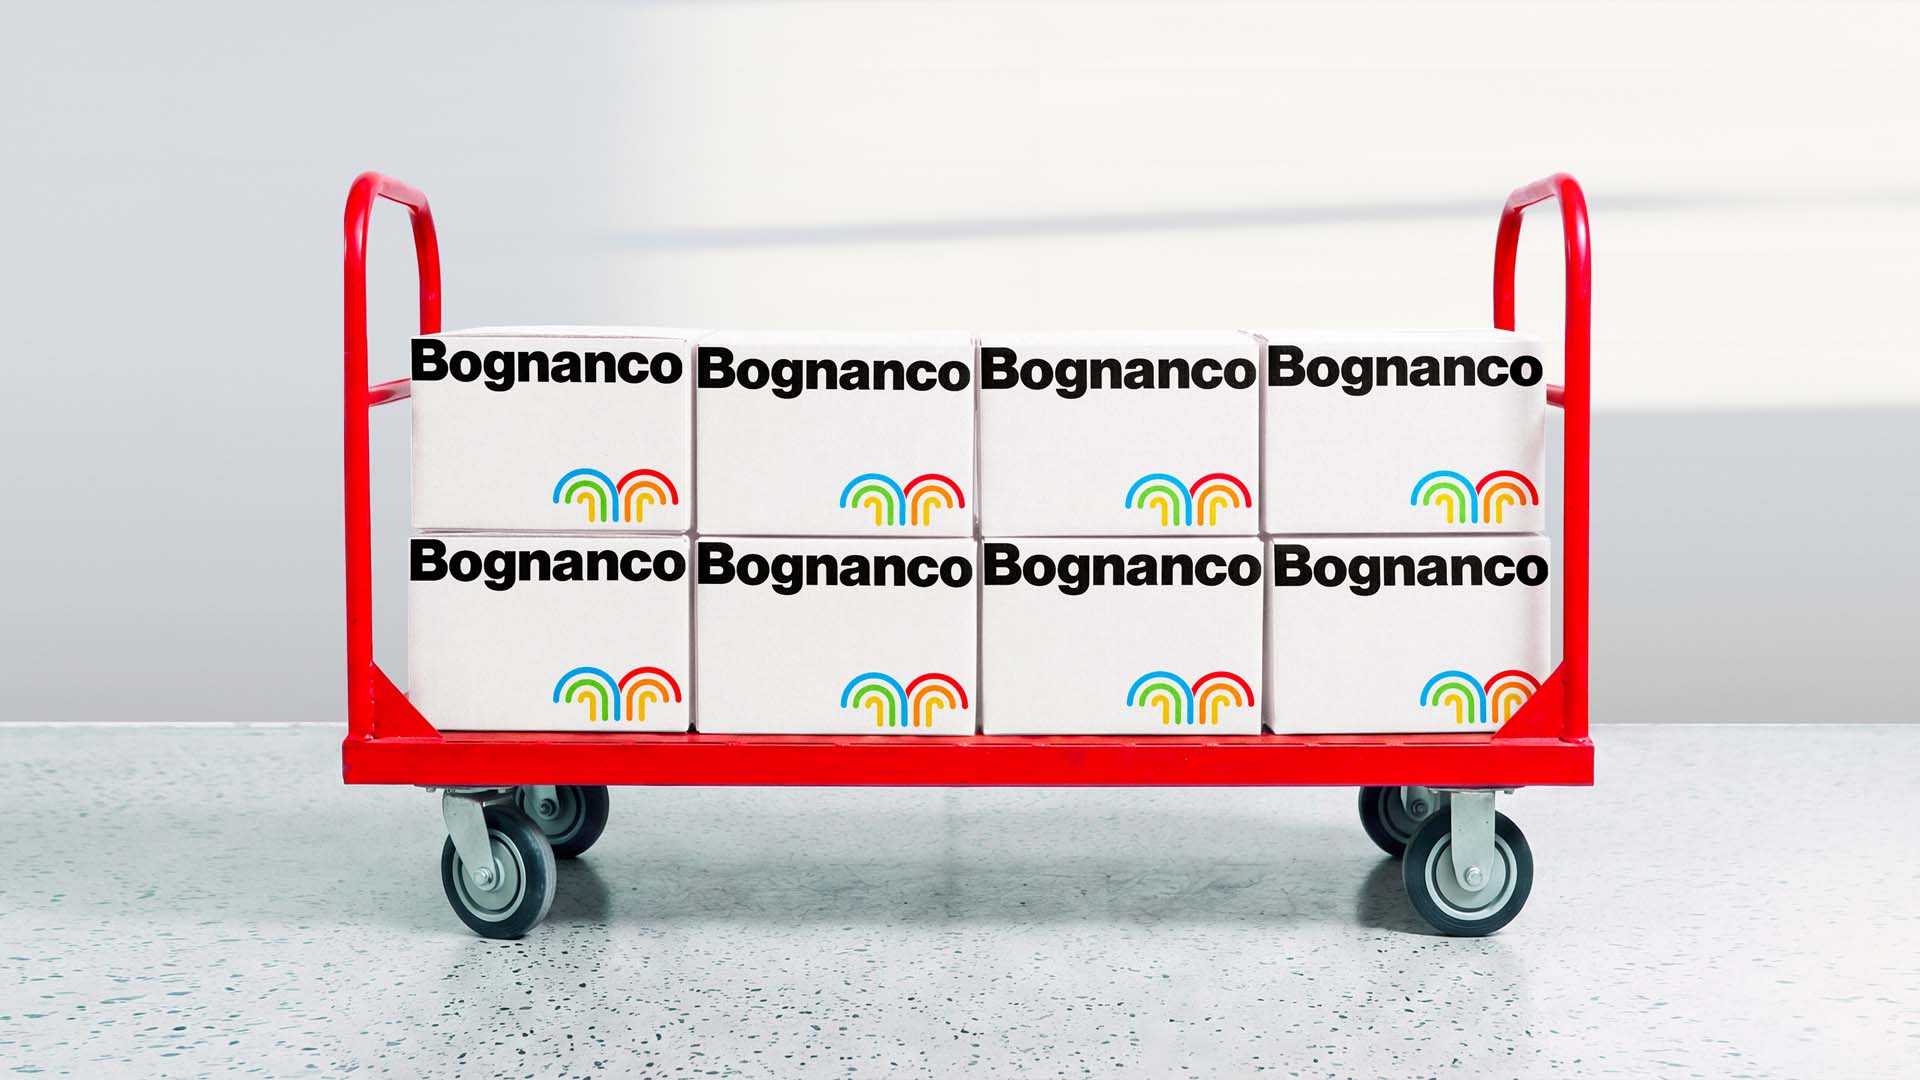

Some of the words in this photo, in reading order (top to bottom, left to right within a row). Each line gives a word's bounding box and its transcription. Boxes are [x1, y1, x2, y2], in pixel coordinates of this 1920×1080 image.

[411, 339, 683, 391] Bognanco
[698, 347, 972, 399] Bognanco
[981, 348, 1257, 400] Bognanco
[1269, 346, 1543, 397] Bognanco
[410, 539, 686, 592] Bognanco
[698, 542, 973, 596] Bognanco
[984, 543, 1262, 596] Bognanco
[1274, 545, 1549, 597] Bognanco
